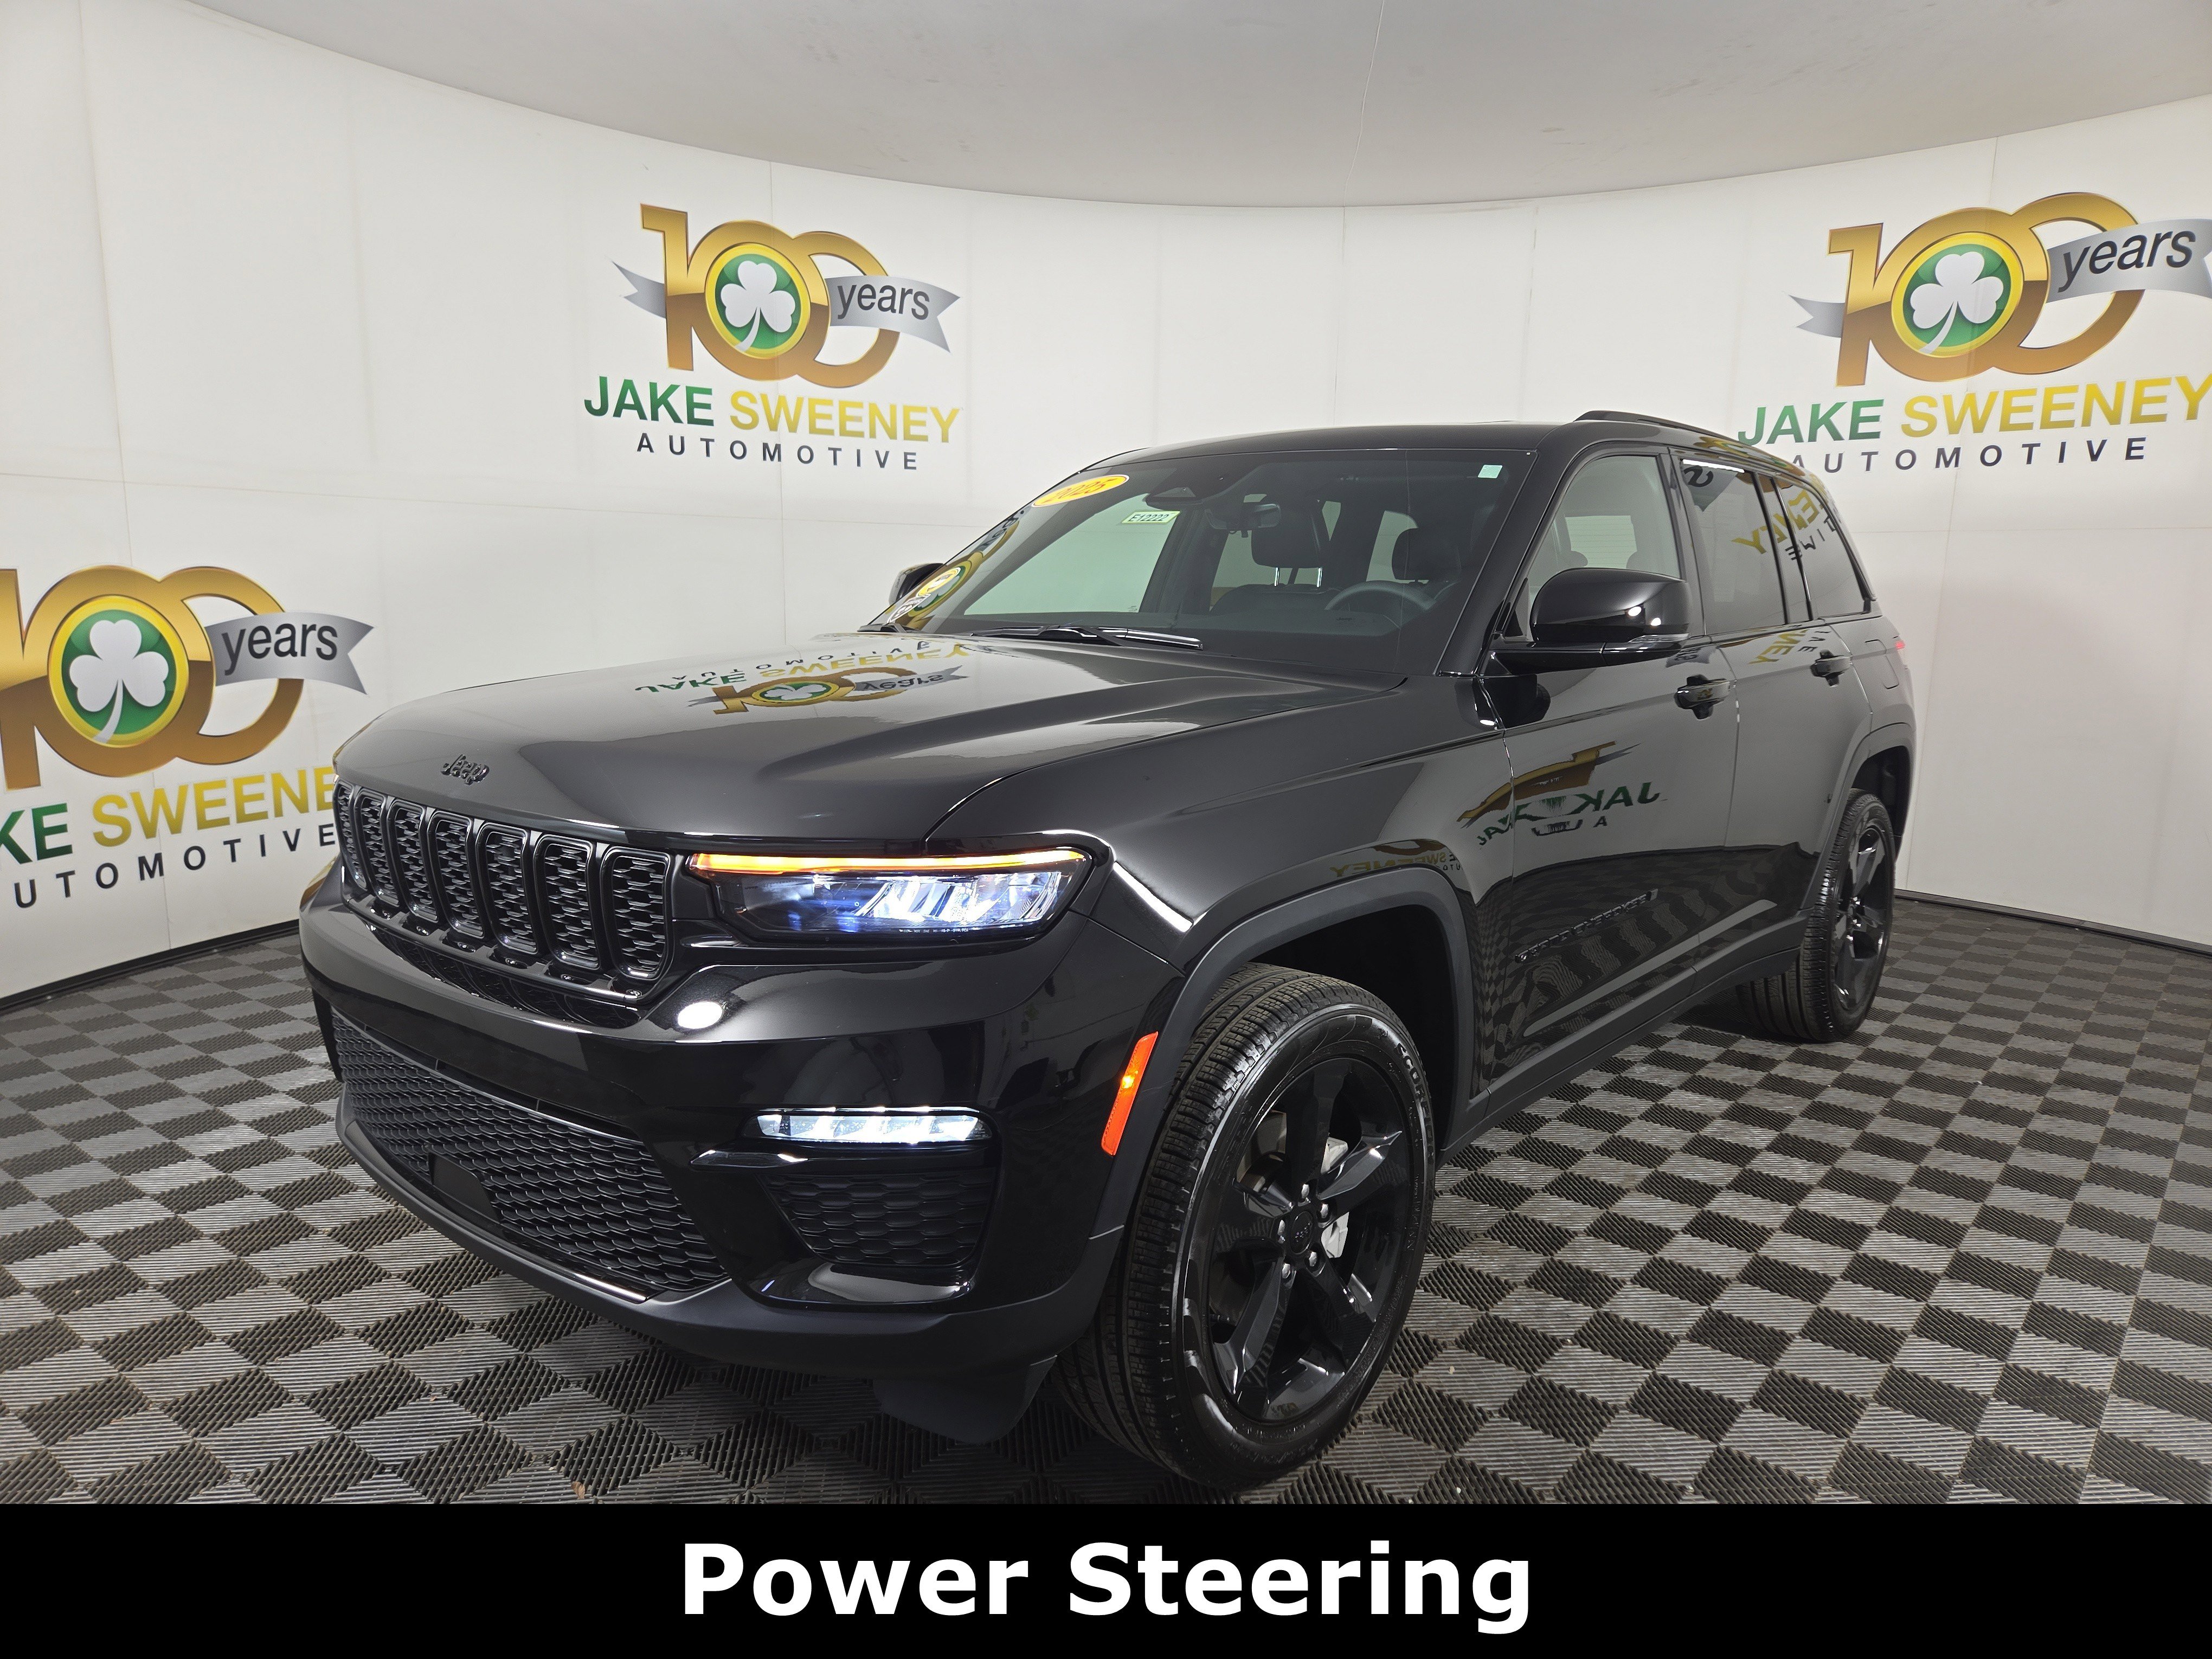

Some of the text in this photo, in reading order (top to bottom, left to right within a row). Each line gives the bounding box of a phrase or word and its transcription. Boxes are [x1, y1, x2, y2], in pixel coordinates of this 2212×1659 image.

[2057, 229, 2197, 293] years
[837, 282, 930, 320] years
[584, 376, 961, 443] JAKE SWEENEY
[1738, 373, 2212, 447] JAKE SWEENEY
[636, 432, 917, 470] AUTOMOTIVE
[1128, 513, 1169, 522] E12222
[221, 622, 338, 676] years
[440, 754, 490, 785] Jeep
[0, 766, 334, 864] KE SWEENE
[14, 823, 335, 909] UTOMOTIVE
